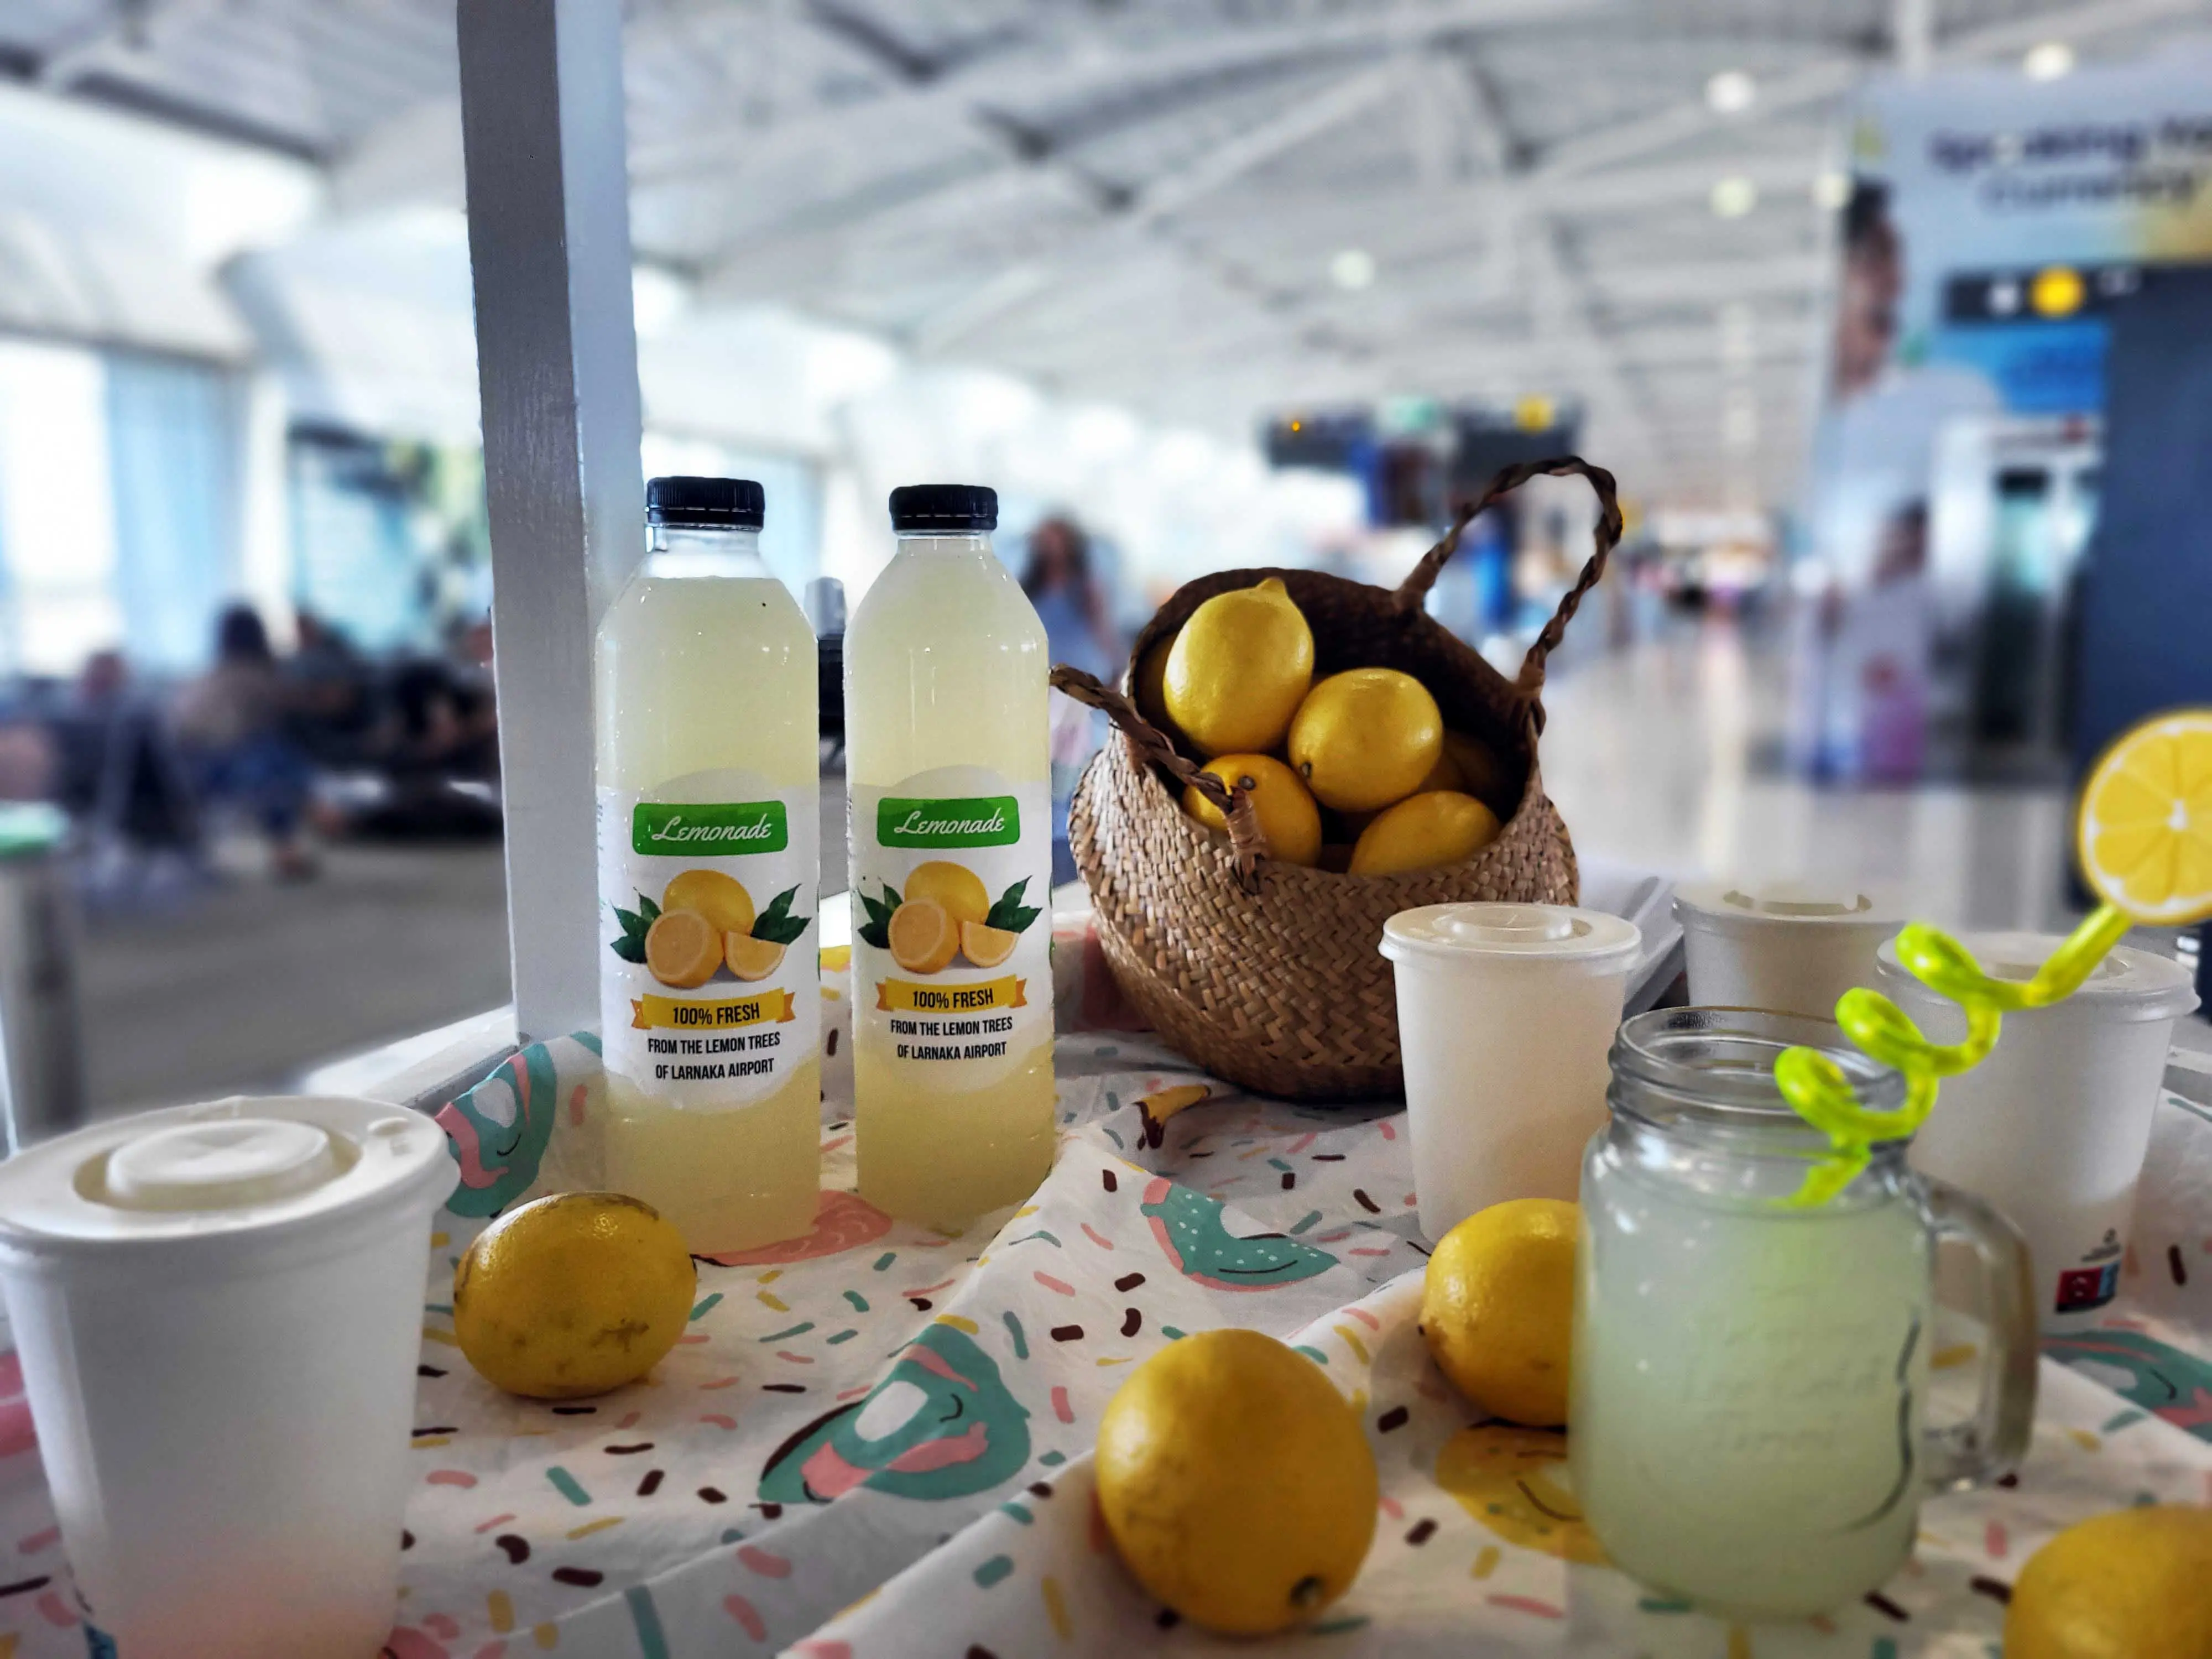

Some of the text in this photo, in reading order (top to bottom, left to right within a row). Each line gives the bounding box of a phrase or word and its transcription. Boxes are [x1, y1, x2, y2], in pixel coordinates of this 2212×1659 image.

[651, 813, 773, 841] Lemonade
[894, 807, 1005, 834] Lemonade
[913, 988, 994, 1008] 100% FRESH
[673, 1002, 760, 1024] 100% FRESH
[891, 1016, 1013, 1036] FROM THE LEMON TREES
[648, 1031, 780, 1054] FROM THE LEMON TREES
[897, 1041, 1007, 1060] OF LARNAKA AIRPORT
[656, 1058, 774, 1079] OF LARNAKA AIRPORT
